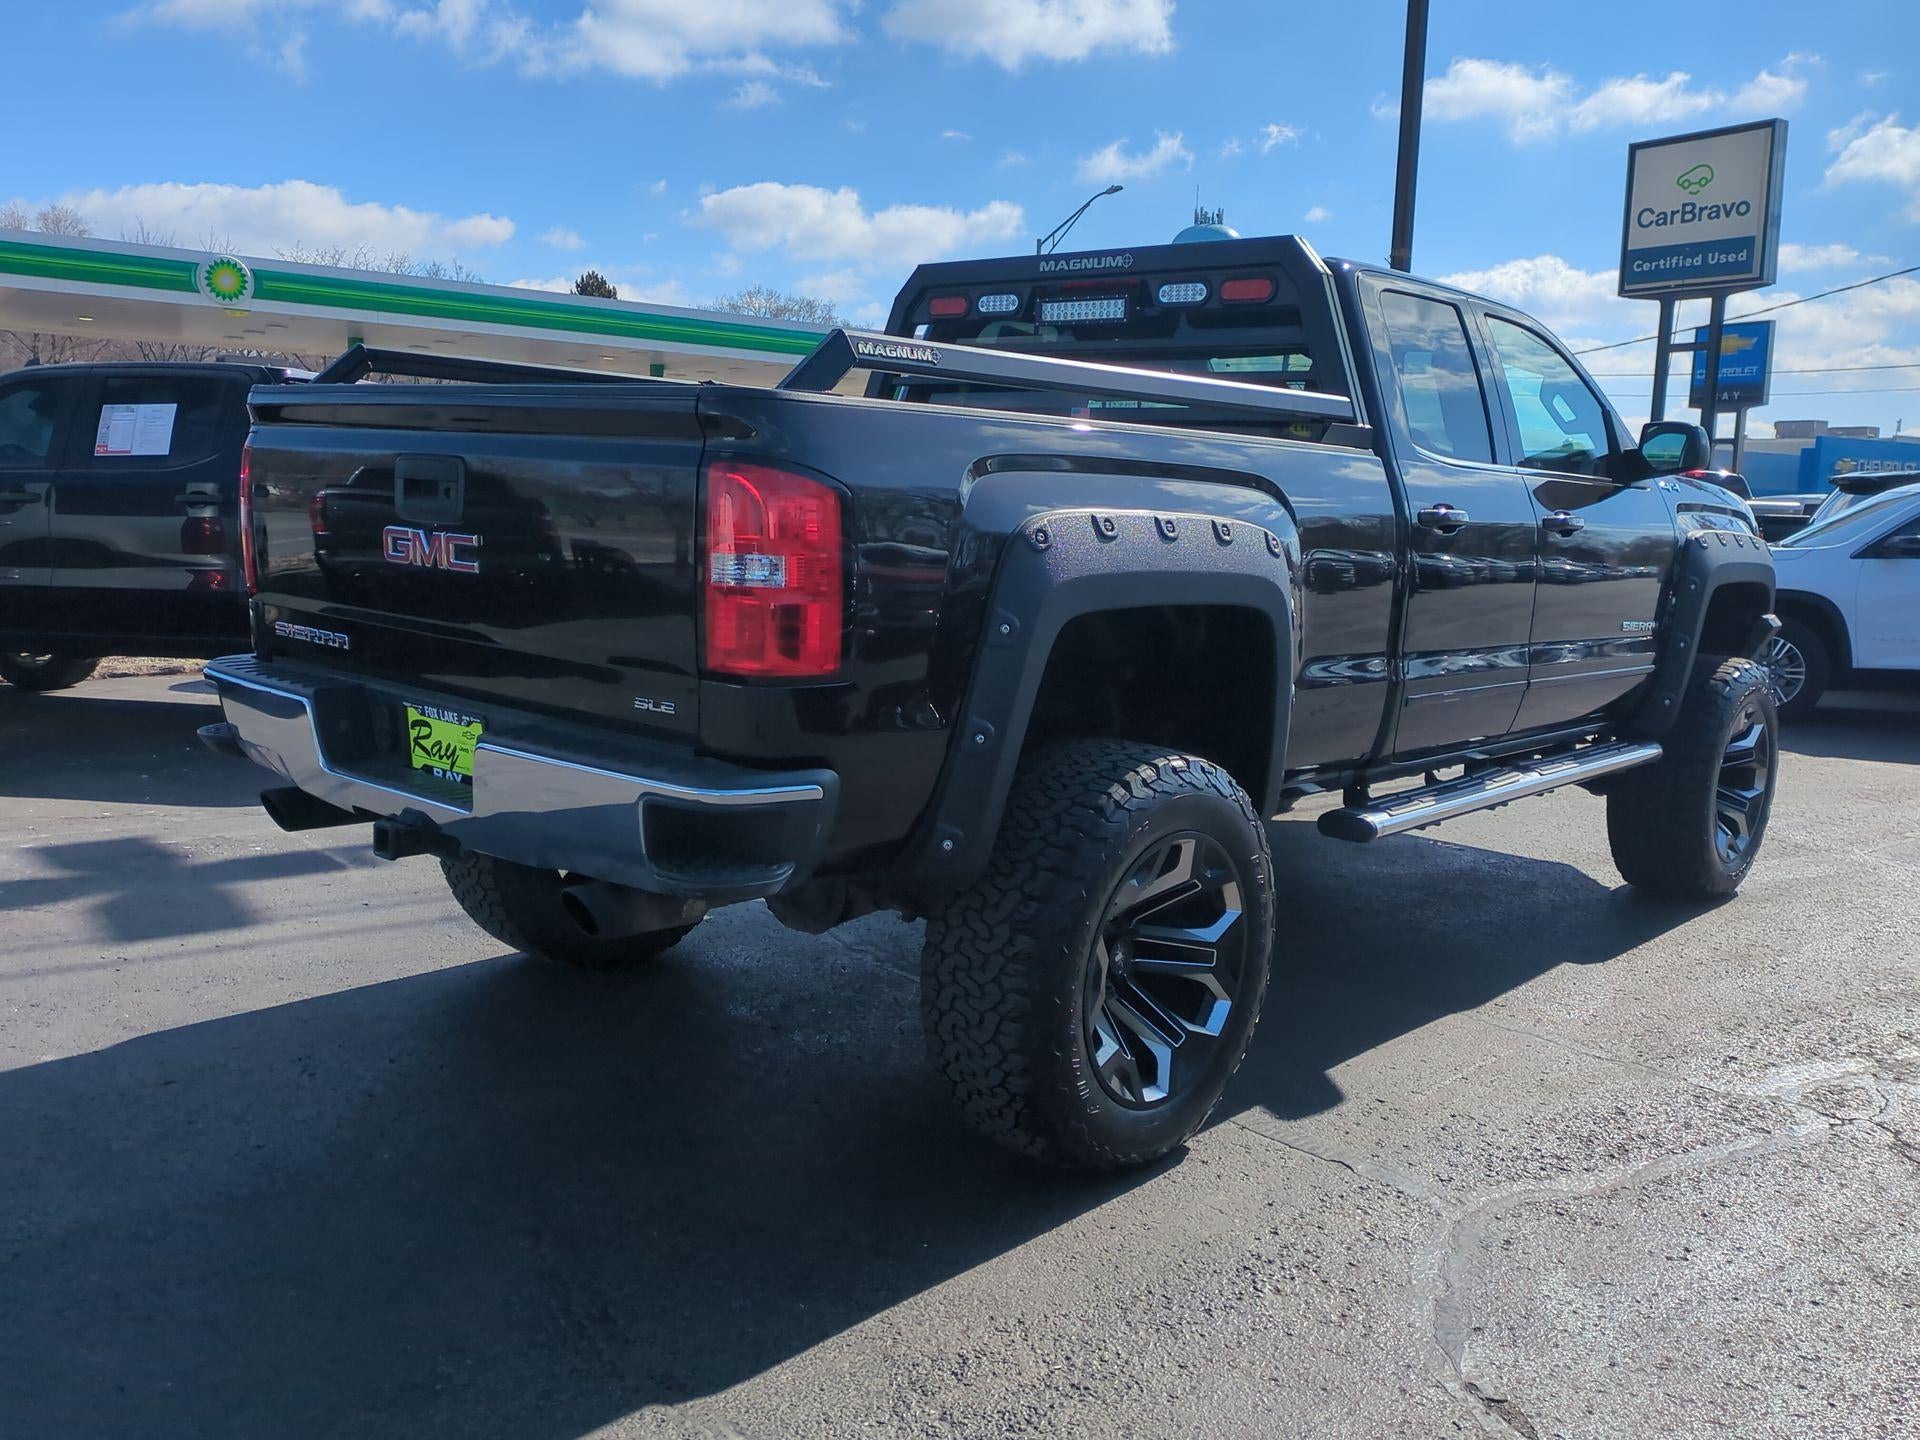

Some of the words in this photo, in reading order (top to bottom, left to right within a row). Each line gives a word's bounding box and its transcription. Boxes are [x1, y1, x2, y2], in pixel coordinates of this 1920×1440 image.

[1637, 200, 1751, 228] CarBravo
[1040, 255, 1123, 272] MAGNUM
[1633, 254, 1702, 272] Certified
[1708, 249, 1747, 264] Used
[857, 341, 932, 361] MAGNUM
[1696, 366, 1759, 379] CVROLET
[383, 525, 480, 574] GMC
[275, 621, 349, 650] SIERRA
[424, 706, 439, 719] FOX
[439, 709, 459, 724] LAKE
[410, 719, 459, 771] Ray
